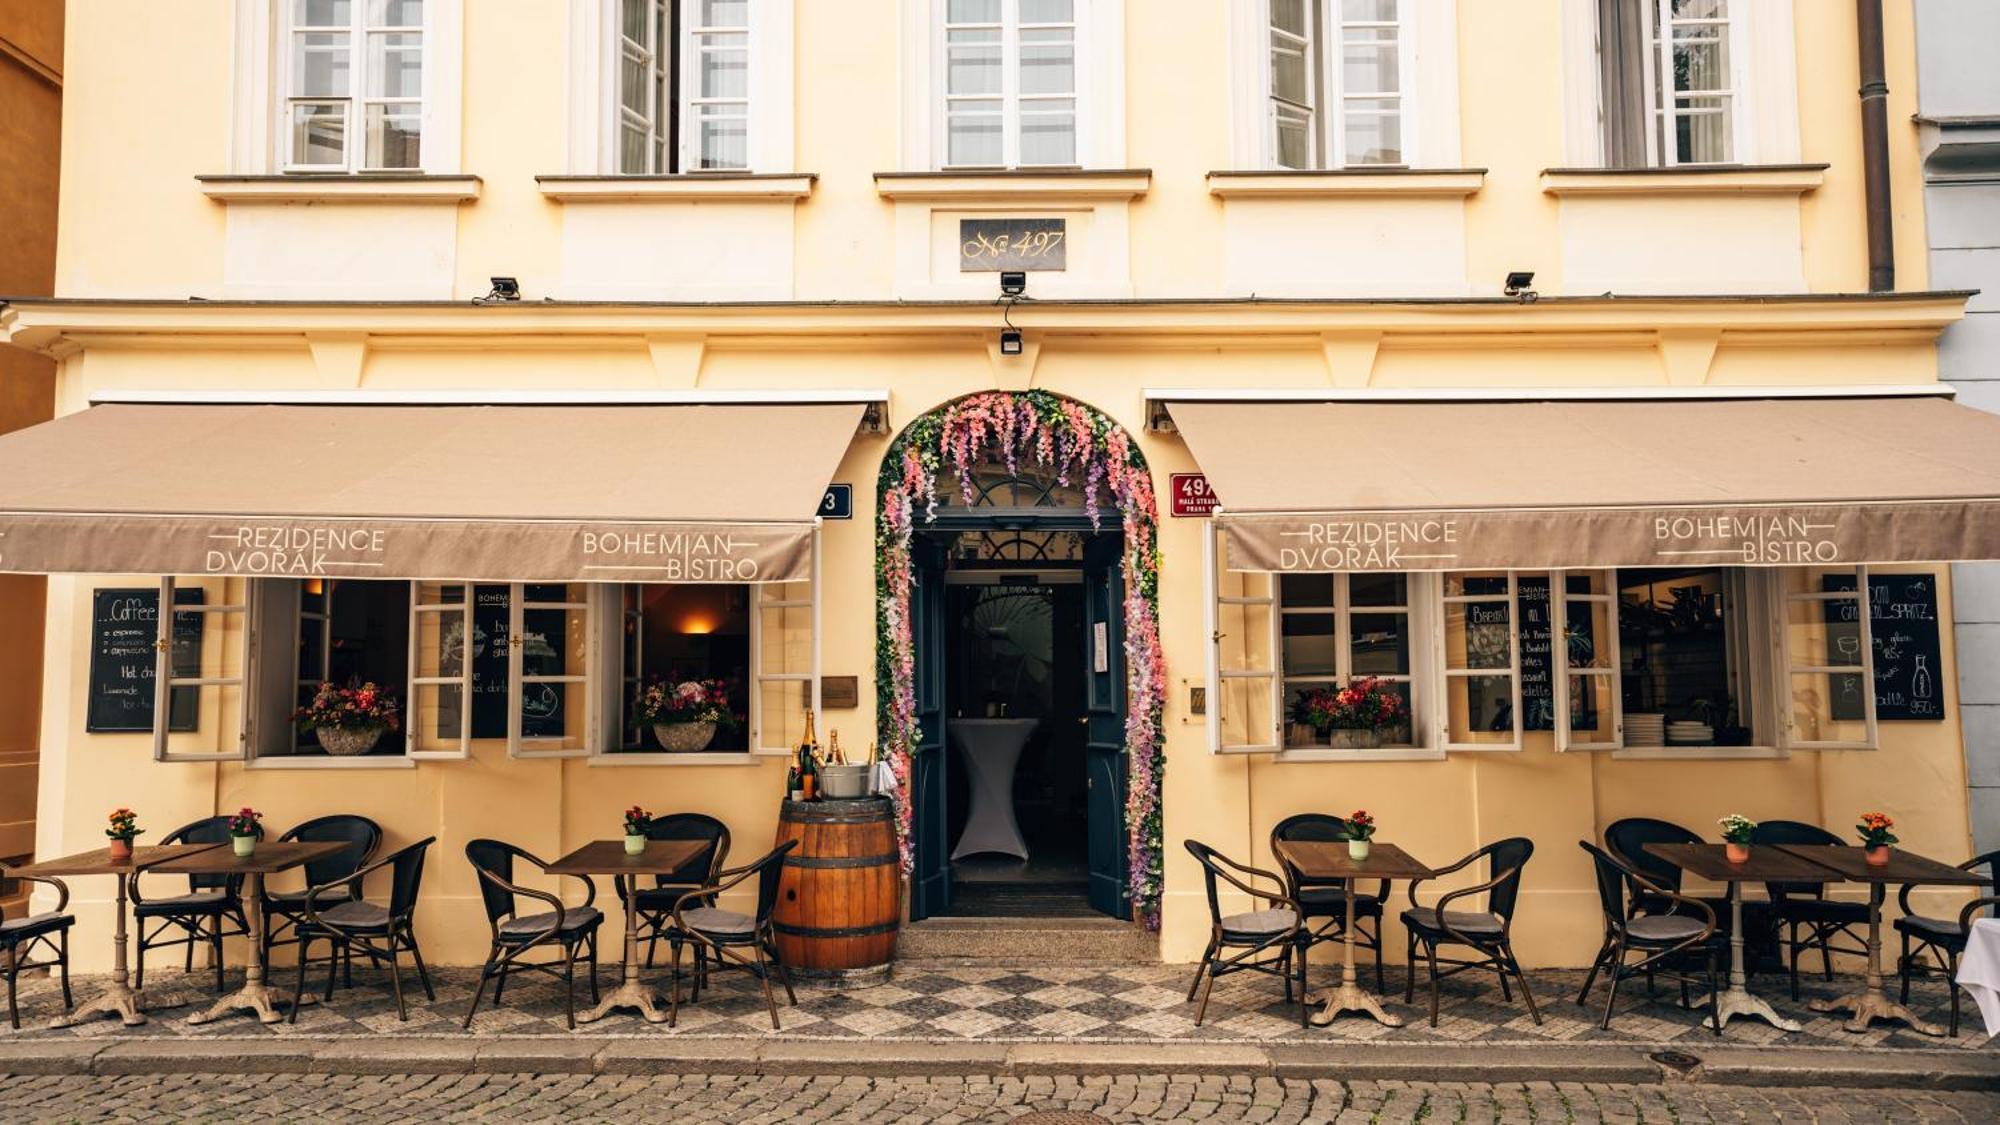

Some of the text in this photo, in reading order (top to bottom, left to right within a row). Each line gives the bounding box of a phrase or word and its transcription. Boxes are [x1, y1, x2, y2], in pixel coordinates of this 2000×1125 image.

[1011, 231, 1064, 257] 497
[824, 492, 836, 510] 3
[237, 526, 385, 552] REZIDENCE
[1309, 521, 1457, 544] REZIDENCE
[1655, 516, 1808, 540] BOHEMIAN
[583, 532, 731, 555] BOHEMIAN
[1743, 540, 1838, 563] BISTRO
[206, 547, 328, 575] DVOŘÁK
[1280, 543, 1401, 569] DVOŘÁK
[667, 557, 759, 580] BISTRO
